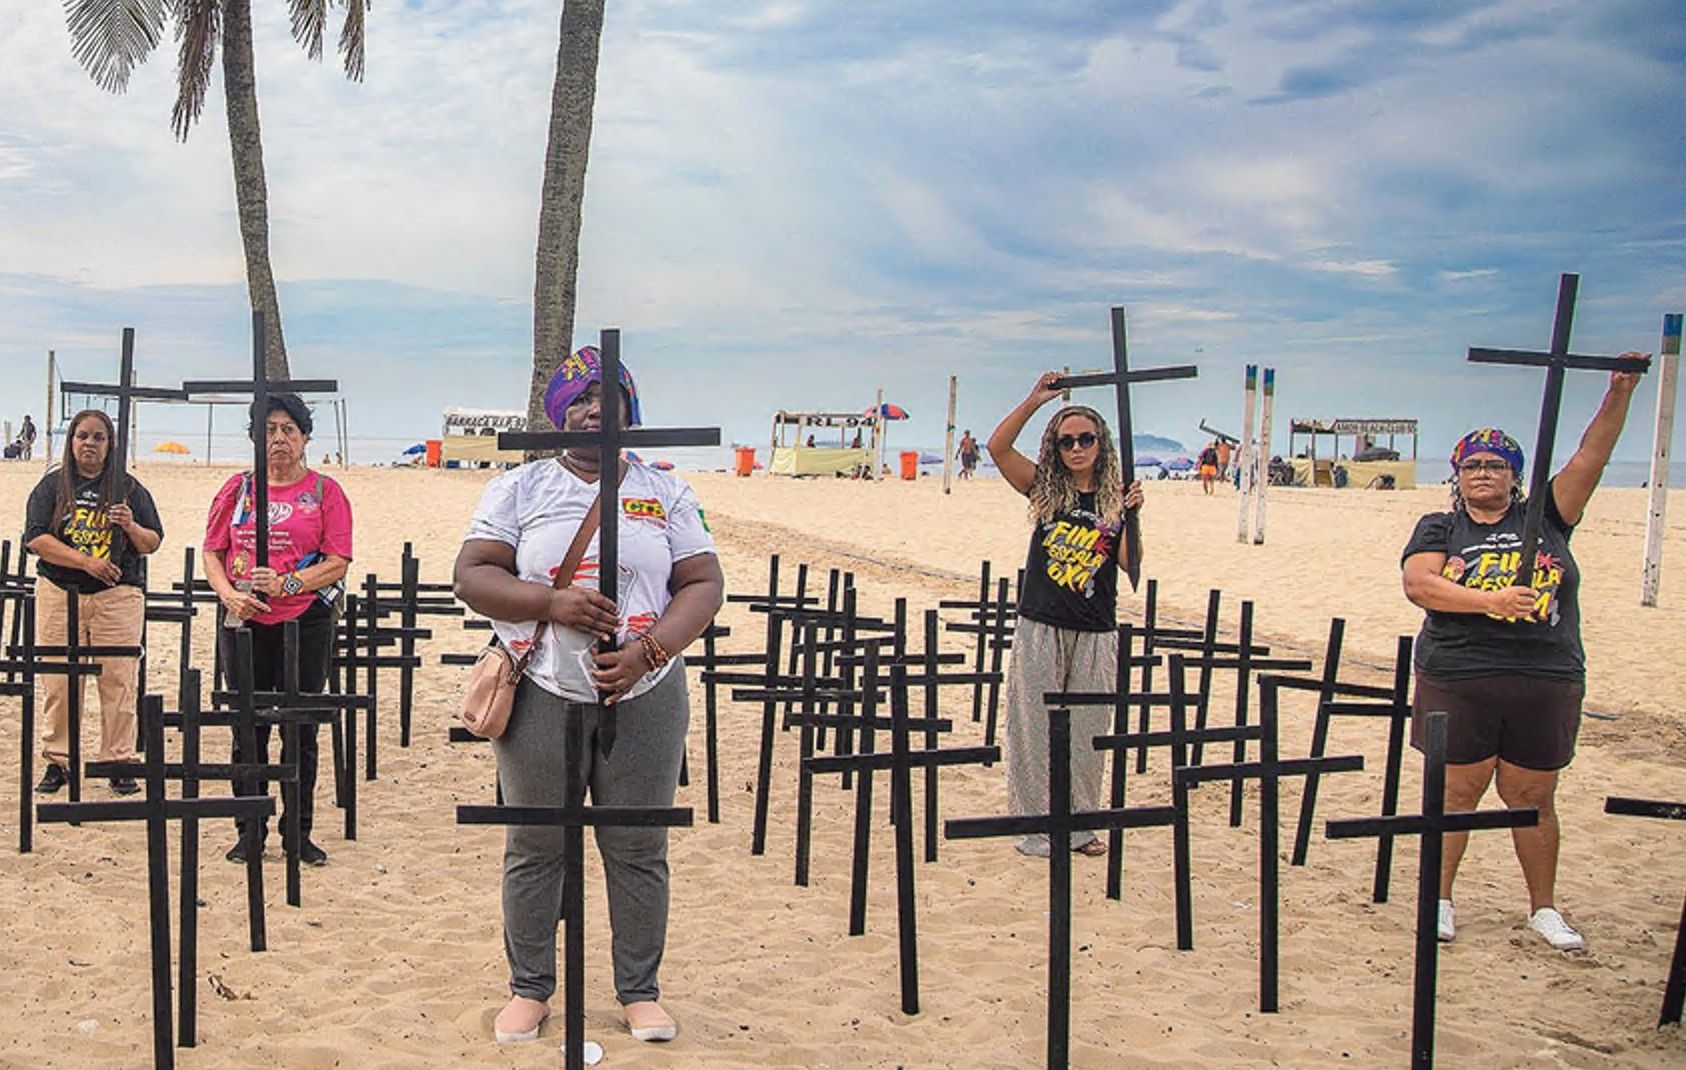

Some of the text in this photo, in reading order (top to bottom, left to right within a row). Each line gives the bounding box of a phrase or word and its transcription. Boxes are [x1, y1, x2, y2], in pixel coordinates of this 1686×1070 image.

[1051, 520, 1101, 551] FIM
[1048, 543, 1104, 568] ESCALA
[1047, 561, 1091, 593] 6X1
